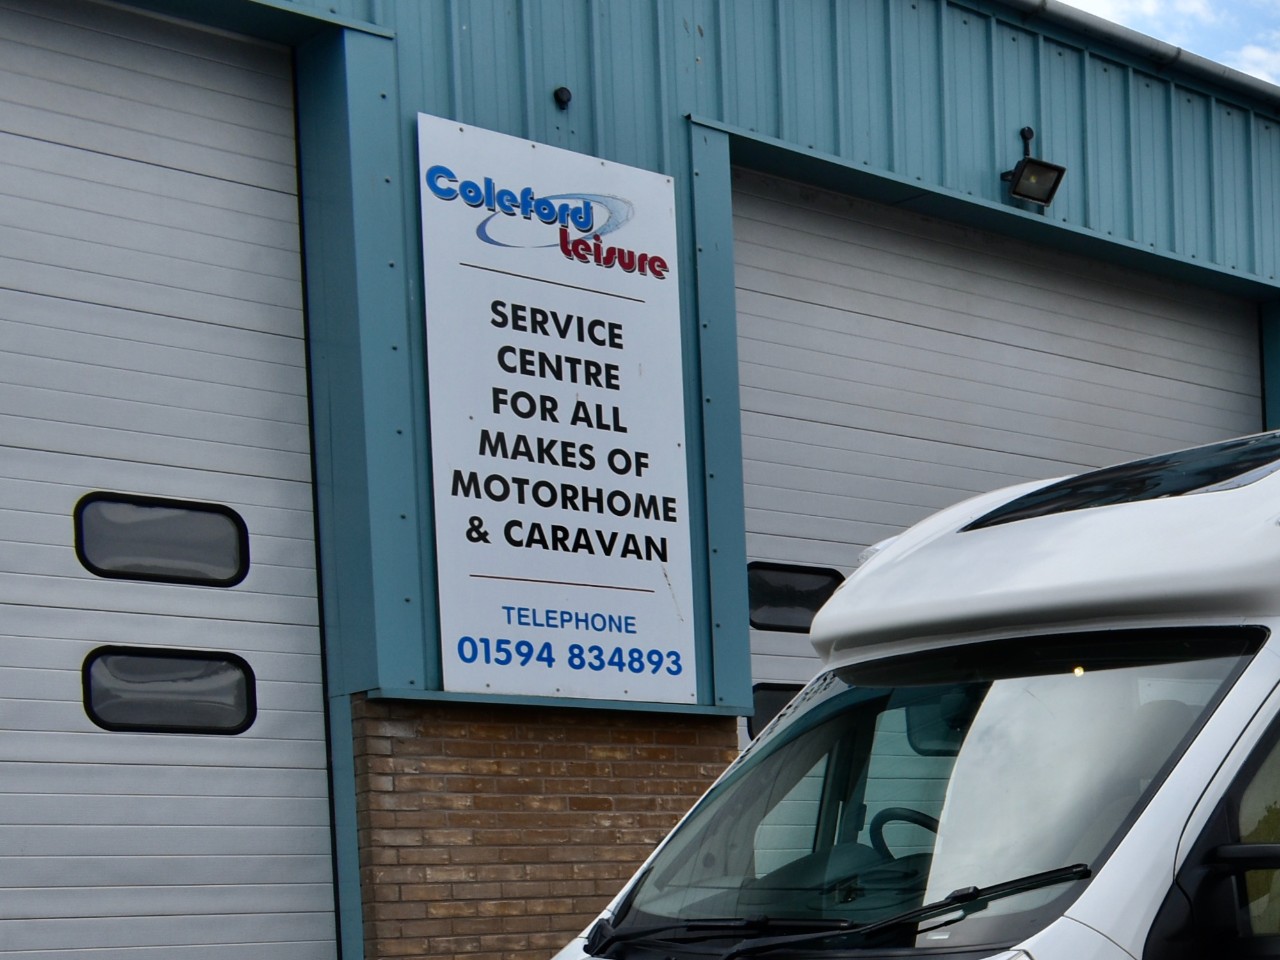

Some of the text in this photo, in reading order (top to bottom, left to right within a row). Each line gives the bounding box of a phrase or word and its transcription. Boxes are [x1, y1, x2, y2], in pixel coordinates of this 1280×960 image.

[426, 165, 594, 232] Coleford
[559, 228, 669, 279] Leisure
[490, 300, 623, 350] SERVICE
[497, 346, 621, 391] CENTRE
[492, 387, 628, 433] FOR ALL
[479, 429, 650, 478] MAKES OF
[451, 469, 678, 523] MOTORHOME
[466, 516, 668, 563] & CARAVAN
[502, 606, 637, 634] TELEPHONE
[457, 636, 683, 676] 01594 834893
